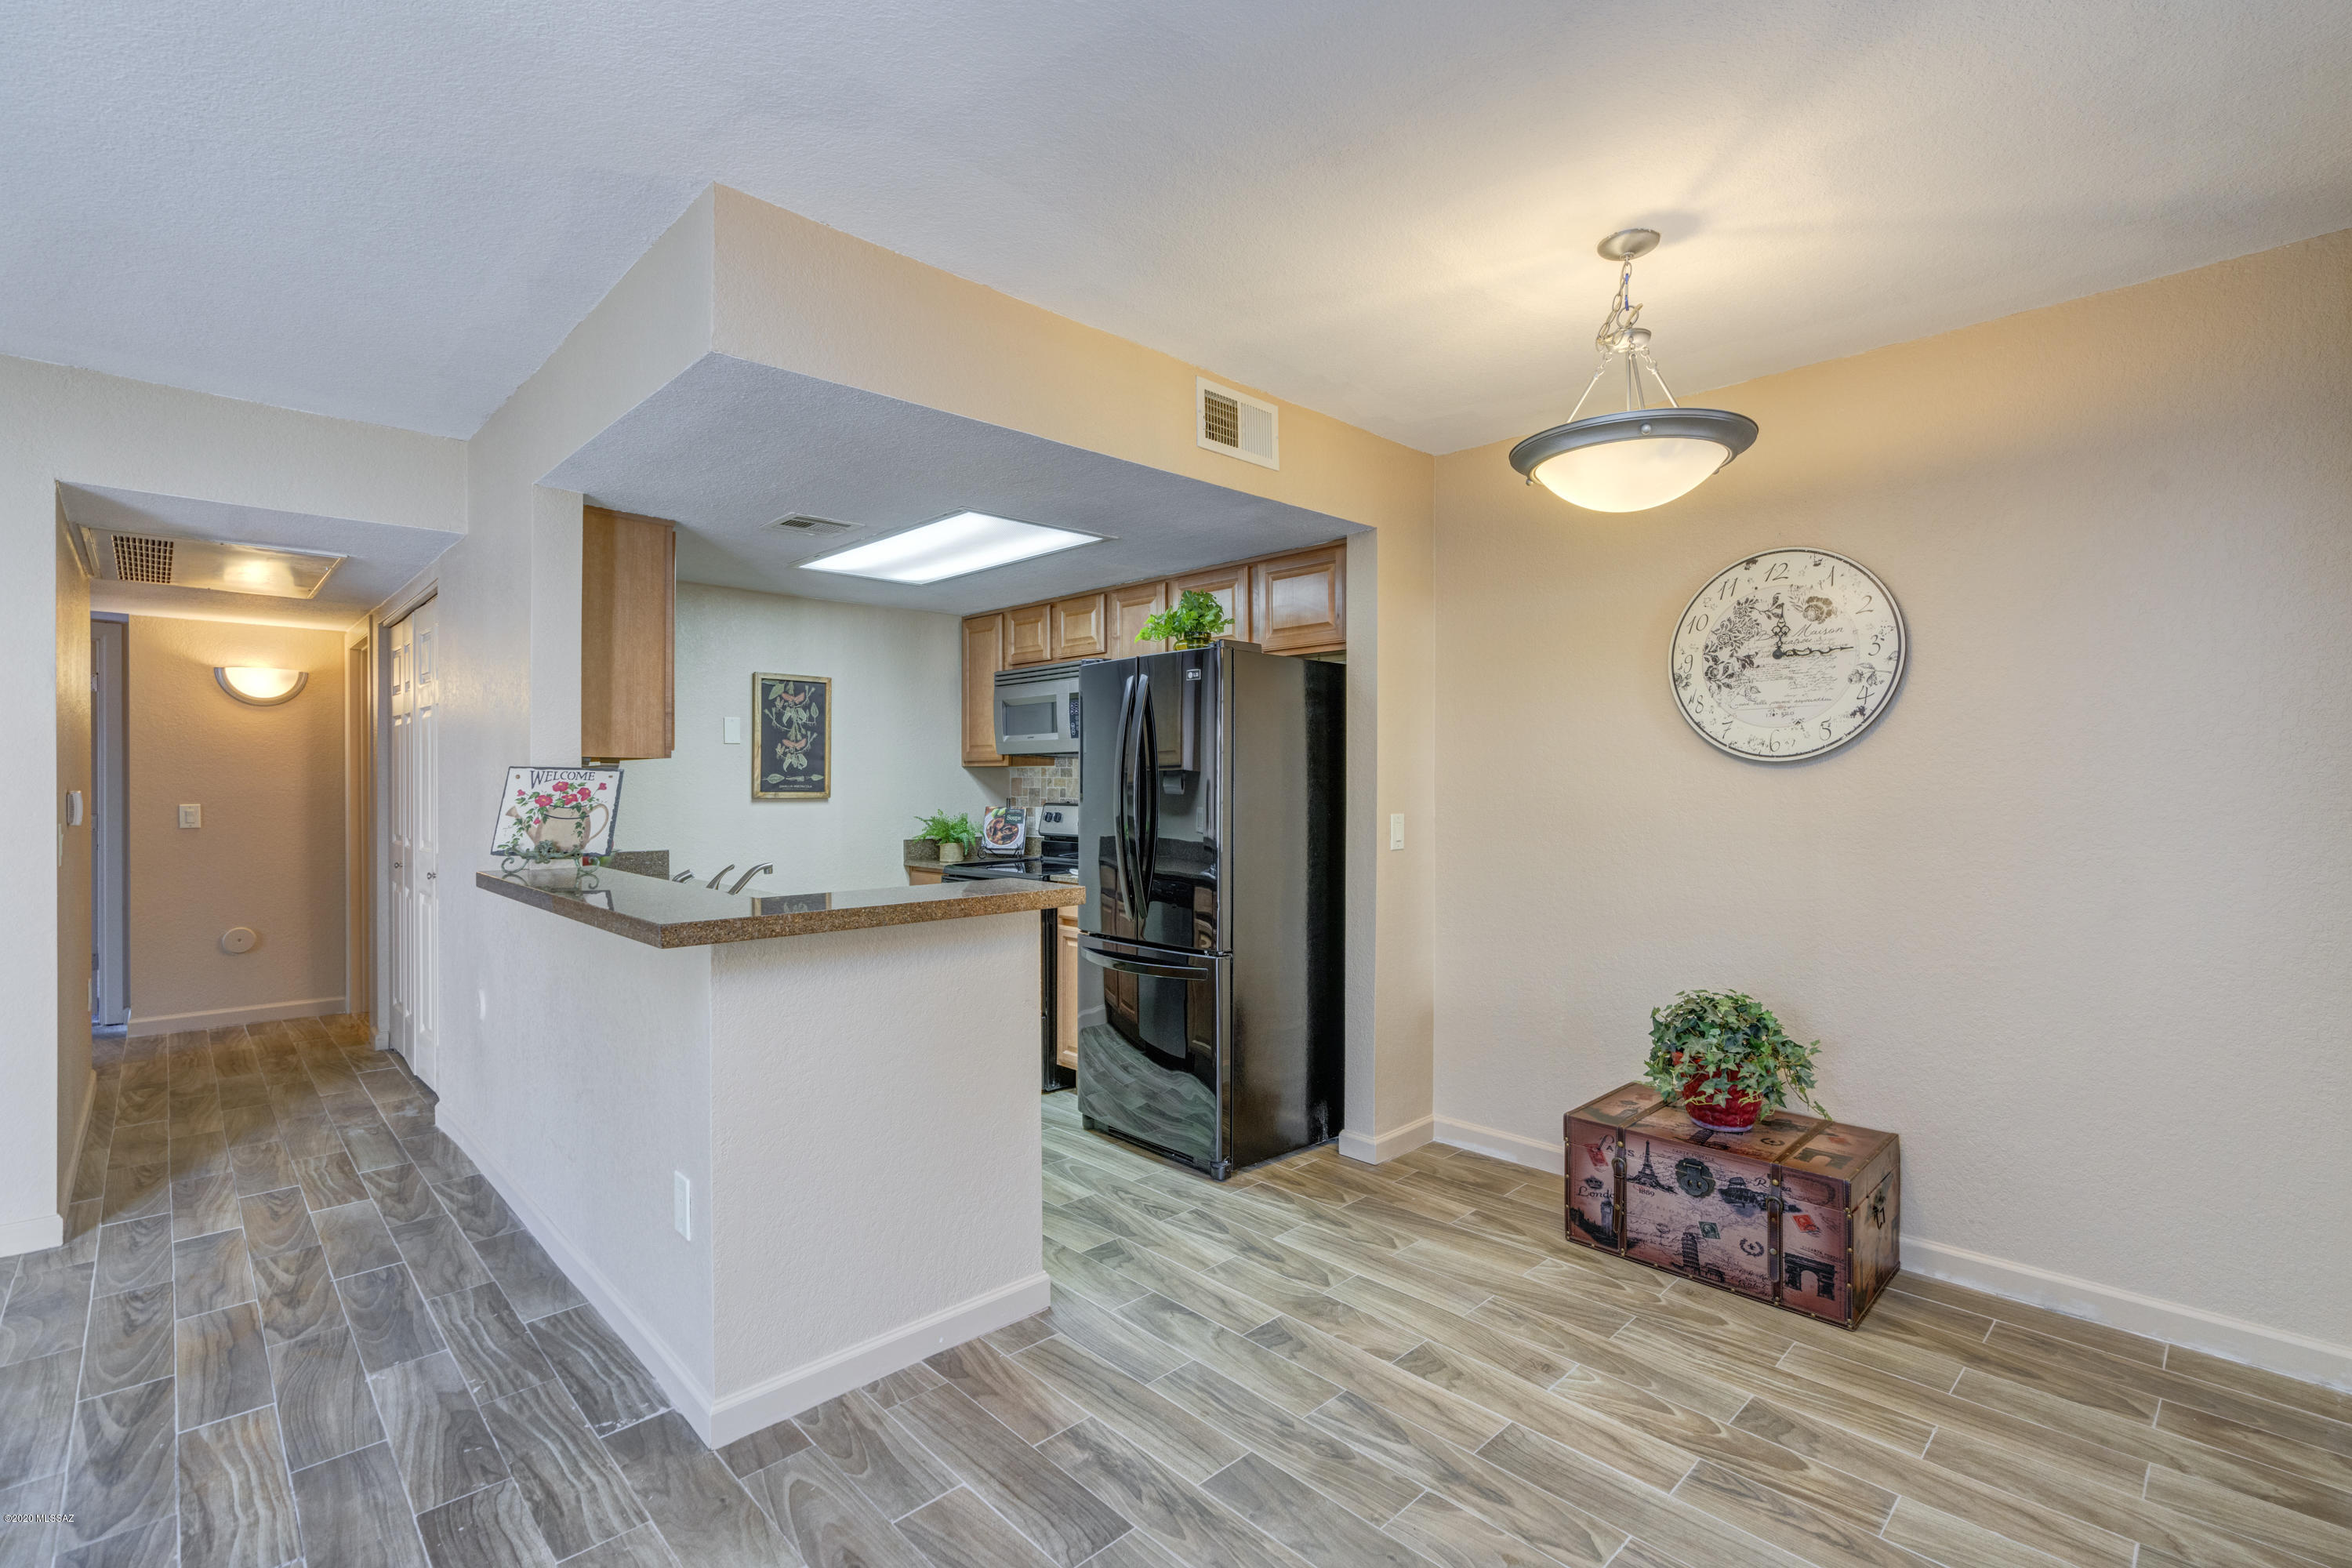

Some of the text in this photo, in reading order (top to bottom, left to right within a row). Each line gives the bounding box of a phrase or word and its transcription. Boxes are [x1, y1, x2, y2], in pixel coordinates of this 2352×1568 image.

[1764, 562, 1788, 583] 12
[1826, 565, 1835, 586] 1
[1718, 577, 1739, 601] 11
[1855, 594, 1874, 615] 2
[1687, 613, 1709, 634] 10
[1868, 634, 1881, 656] 3
[1685, 654, 1693, 673] 9
[1695, 695, 1704, 714] 8
[1857, 685, 1875, 705] 4
[1722, 720, 1733, 739] 7
[1819, 718, 1832, 741] 5
[1769, 729, 1780, 753] 6
[530, 770, 596, 789] WELCOME
[1576, 1186, 1615, 1199] Londo
[1639, 1188, 1655, 1198] 1889
